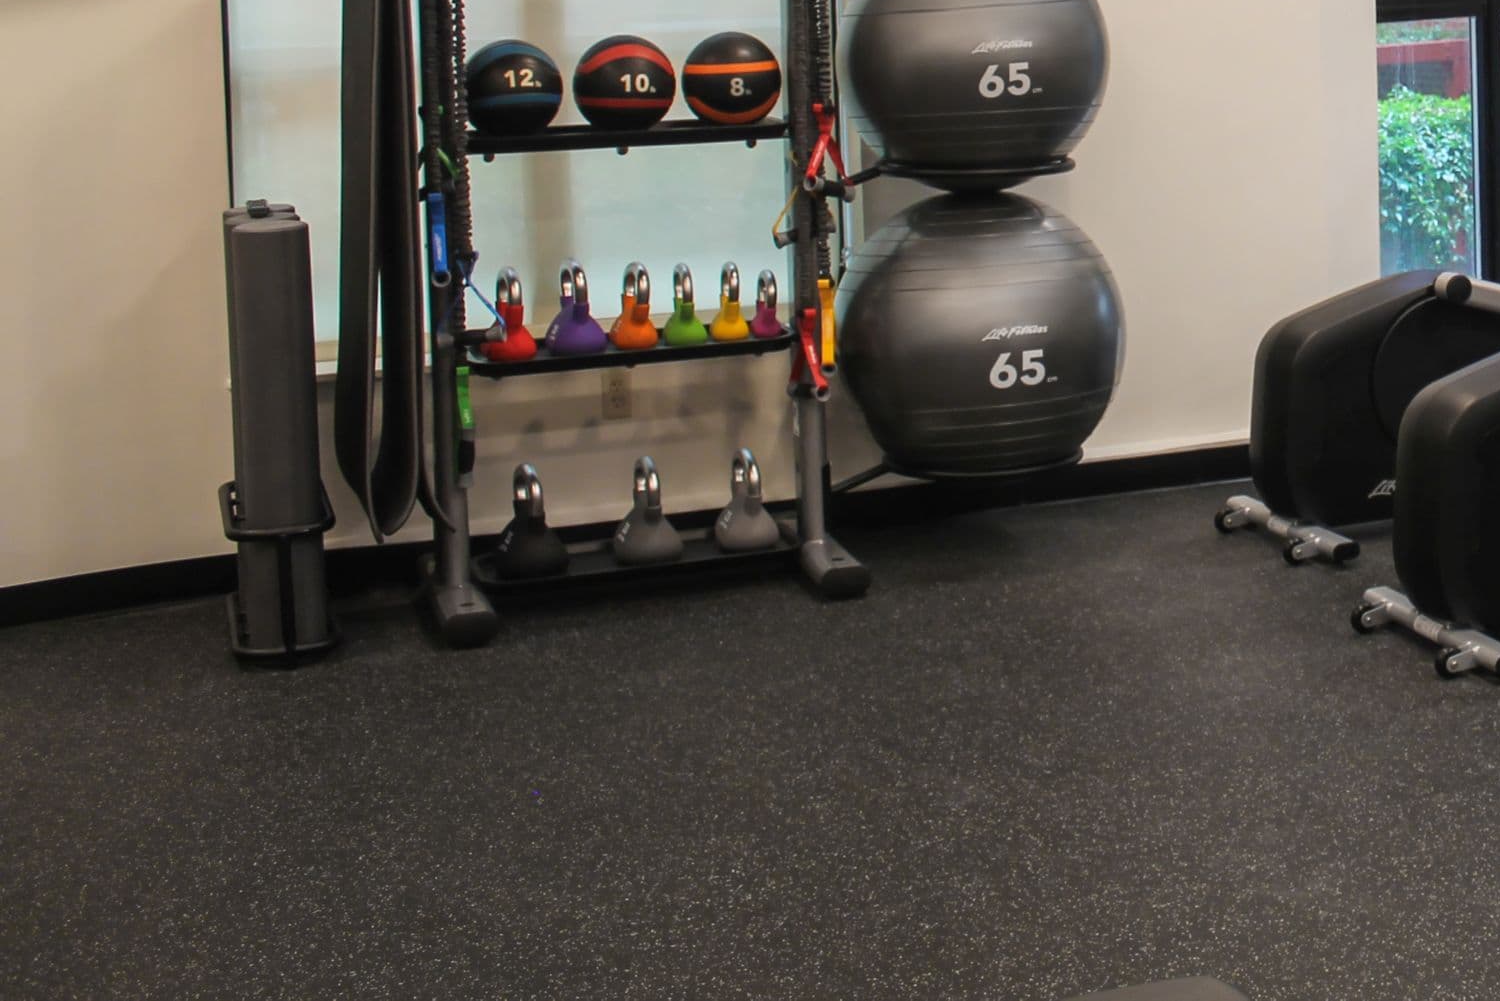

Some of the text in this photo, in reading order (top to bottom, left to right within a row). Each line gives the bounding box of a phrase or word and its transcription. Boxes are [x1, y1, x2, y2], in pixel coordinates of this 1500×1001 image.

[503, 68, 534, 88] 12
[620, 73, 650, 93] 10
[730, 77, 745, 96] 8
[979, 62, 1032, 98] 65
[989, 349, 1046, 389] 65
